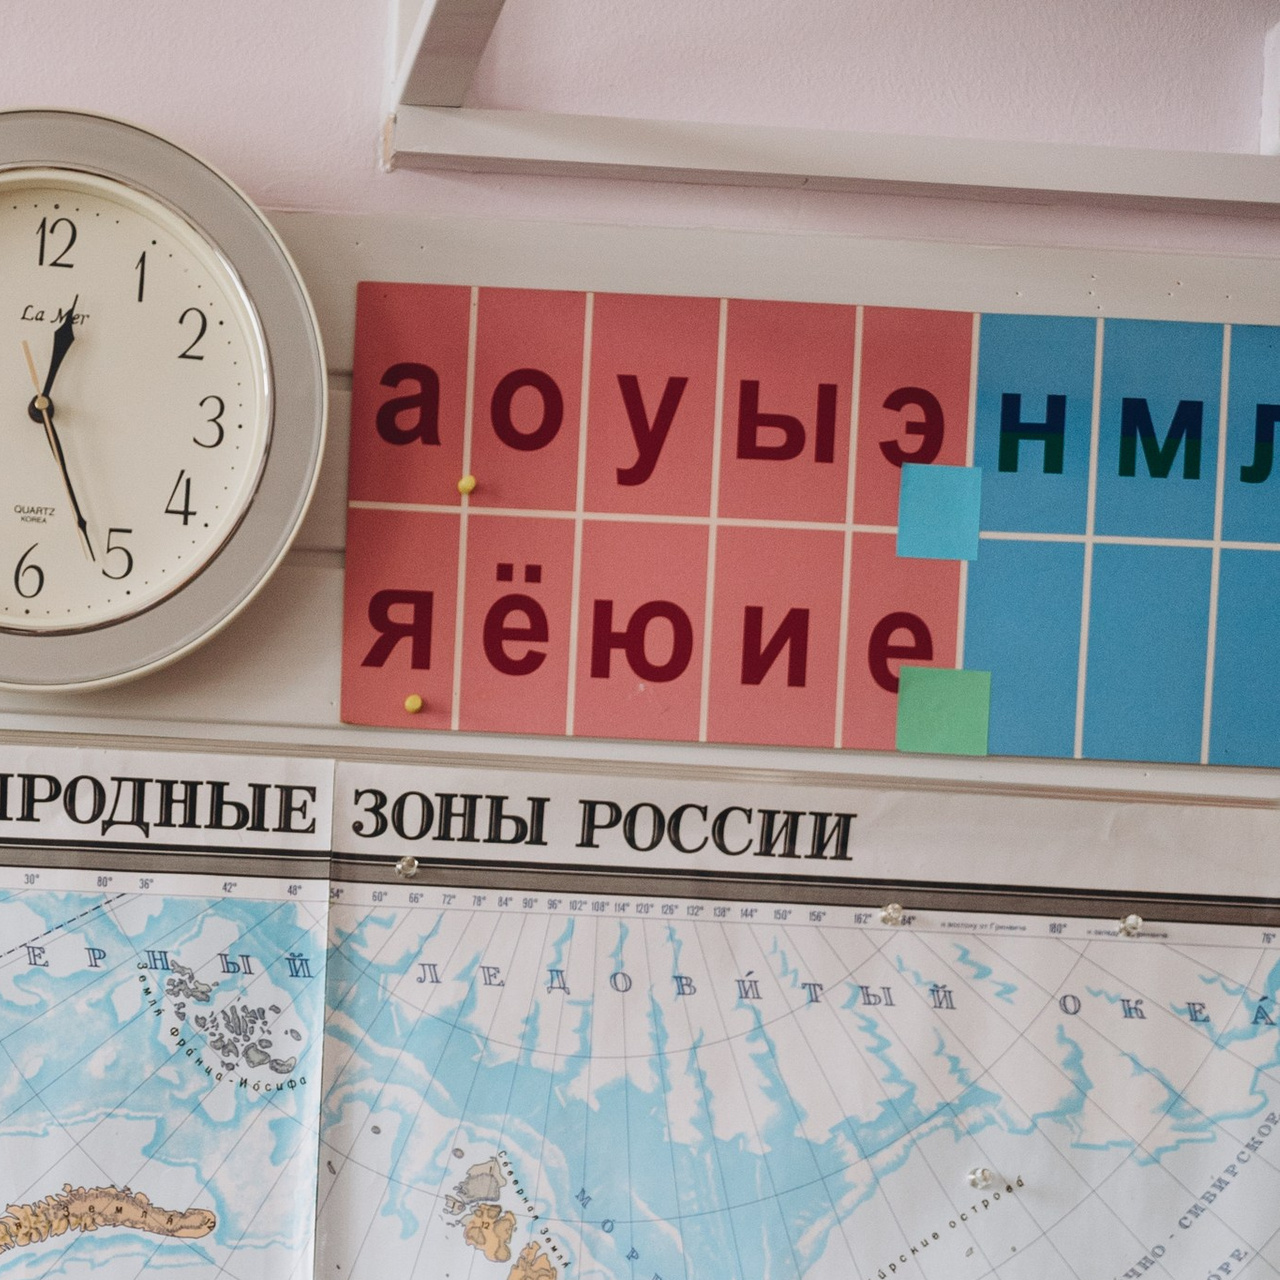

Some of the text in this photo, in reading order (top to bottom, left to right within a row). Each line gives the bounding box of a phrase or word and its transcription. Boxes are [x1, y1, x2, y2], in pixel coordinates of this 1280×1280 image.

[36, 217, 78, 268] 12
[135, 251, 146, 302] 1
[21, 304, 45, 322] La
[177, 308, 208, 361] 2
[192, 395, 226, 448] 3
[375, 362, 945, 487] а о у ы э
[998, 393, 1067, 474] н
[1118, 397, 1204, 480] м
[14, 505, 55, 517] QUARTZ
[21, 515, 48, 524] KOREA
[164, 469, 197, 526] 4
[14, 542, 45, 598] 6
[102, 527, 134, 580] 5
[360, 562, 933, 696] я ё ю и е
[351, 788, 549, 846] ЗОНЫ
[578, 798, 858, 862] РОССИИ
